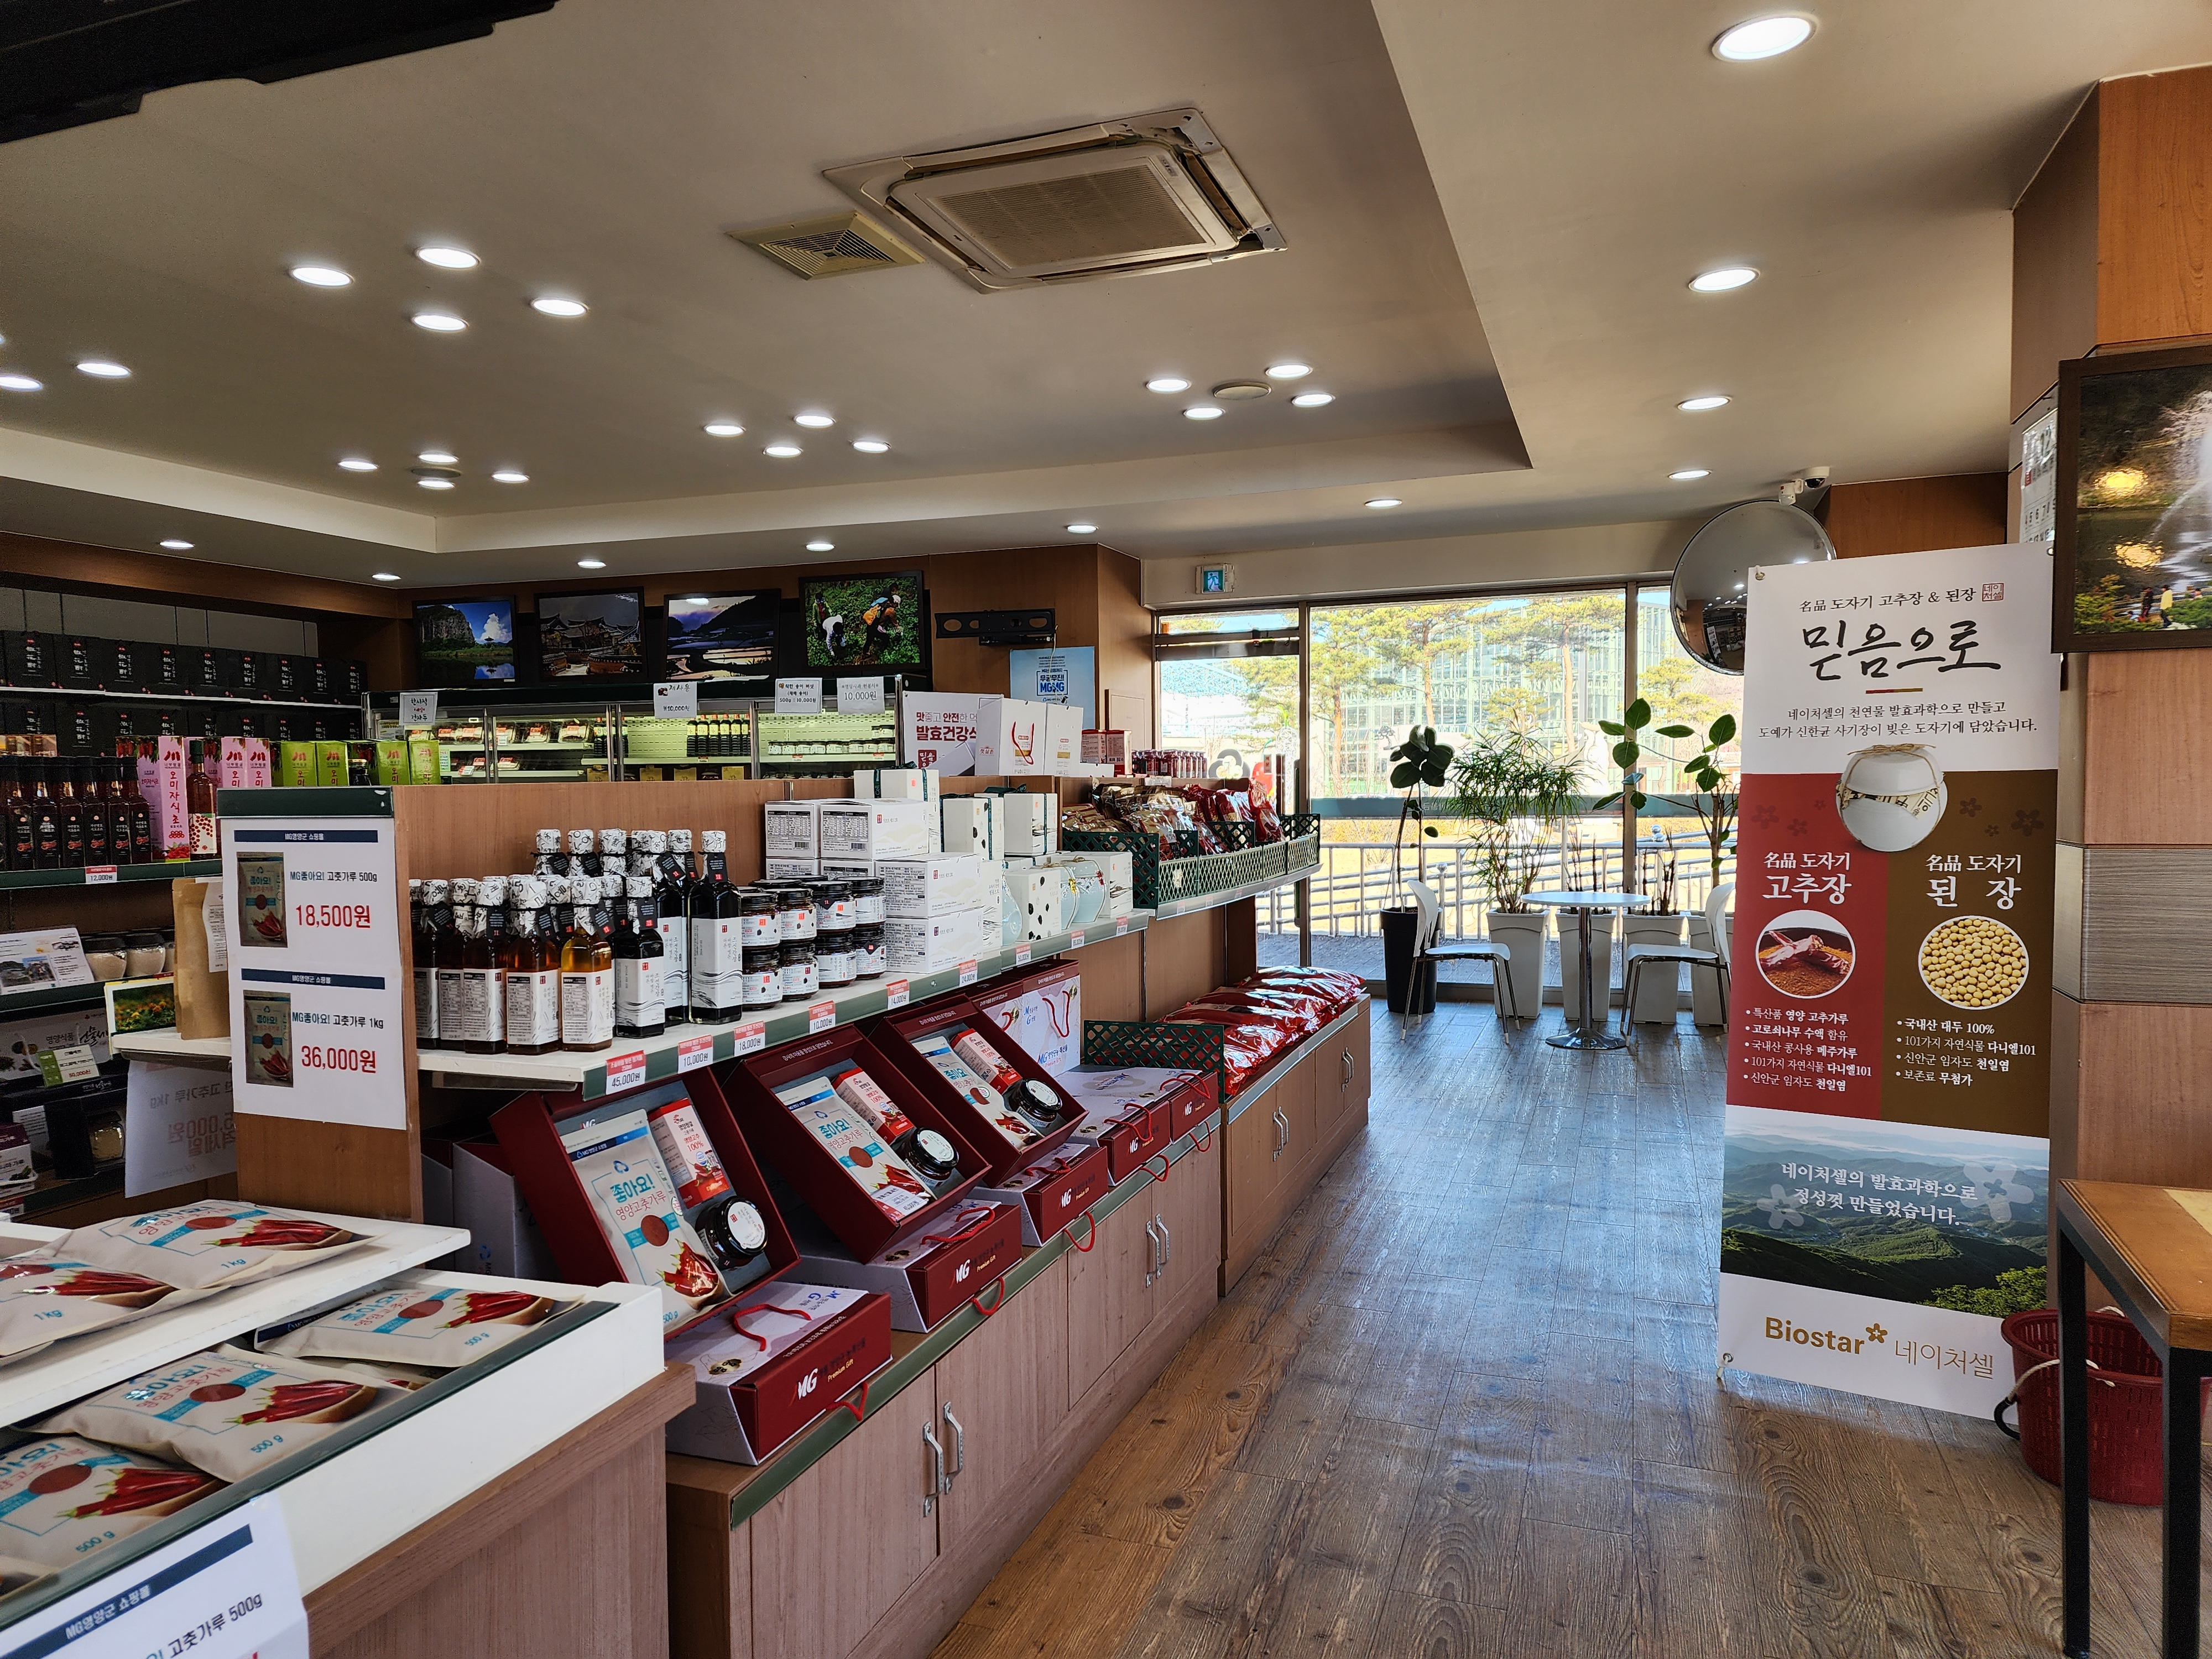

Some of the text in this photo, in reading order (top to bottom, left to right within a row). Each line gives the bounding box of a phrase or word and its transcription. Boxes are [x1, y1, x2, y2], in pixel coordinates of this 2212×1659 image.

[1799, 587, 1976, 612] 名品 도자기 고추장 & 된장
[1802, 620, 2001, 681] 믿음으로
[916, 712, 941, 723] 맛좋고
[943, 712, 968, 723] 안전한
[1788, 701, 2006, 721] 네이처셀의 천연물 발효과학으로 만들고
[1758, 718, 2037, 739] 도예가 신한균 사기장이 빚은 도자기에 담았습니다.
[169, 771, 180, 824] 오미자식초
[1764, 852, 1851, 870] 名品 도자기
[1926, 854, 2022, 874] 名品 도자기
[290, 870, 378, 883] MG좋아요! 고춧가루 500g
[1762, 873, 1853, 905] 고추장
[1926, 877, 2022, 910] 된 장
[295, 904, 372, 929] 18,500원
[292, 1011, 384, 1029] MG좋아요! 고춧가루 1kg
[1752, 1008, 1849, 1023] 특산품 영양 고추가루
[1751, 1024, 1848, 1041] 고로쇠나무 수액 함유
[1904, 1018, 1995, 1035] 국내산 대두 100%
[1751, 1040, 1858, 1058] 국내산 콩사용 메주가루
[1905, 1035, 2036, 1056] 101가지 자연식물 다니엘101
[301, 1045, 377, 1073] 36,000원
[1751, 1056, 1872, 1077] 101가지 자연식물 다니엘101
[1904, 1052, 2010, 1072] 신안군 임자도 천일염
[612, 1072, 640, 1088] 45,000원
[1751, 1072, 1846, 1092] 신안군 임자도 천일염
[1903, 1068, 1973, 1087] 보존료 무첨가
[818, 1118, 853, 1139] 좋아요!
[687, 1140, 704, 1152] 100%
[610, 1173, 655, 1203] 좋아요!
[1781, 1162, 1978, 1201] 네이처셀의 발효과학으로
[616, 1190, 666, 1221] 영양고춧가루
[1793, 1187, 1961, 1225] 정성껏 만들었습니다.
[955, 1259, 971, 1284] MG
[977, 1260, 990, 1272] Premium
[1765, 1316, 1994, 1380] Biostar 네이처셀
[797, 1358, 854, 1400] MG Premium Gift
[65, 1584, 152, 1641] MG영양군 쇼핑몰
[168, 1593, 263, 1658] 고춧가루 500g
